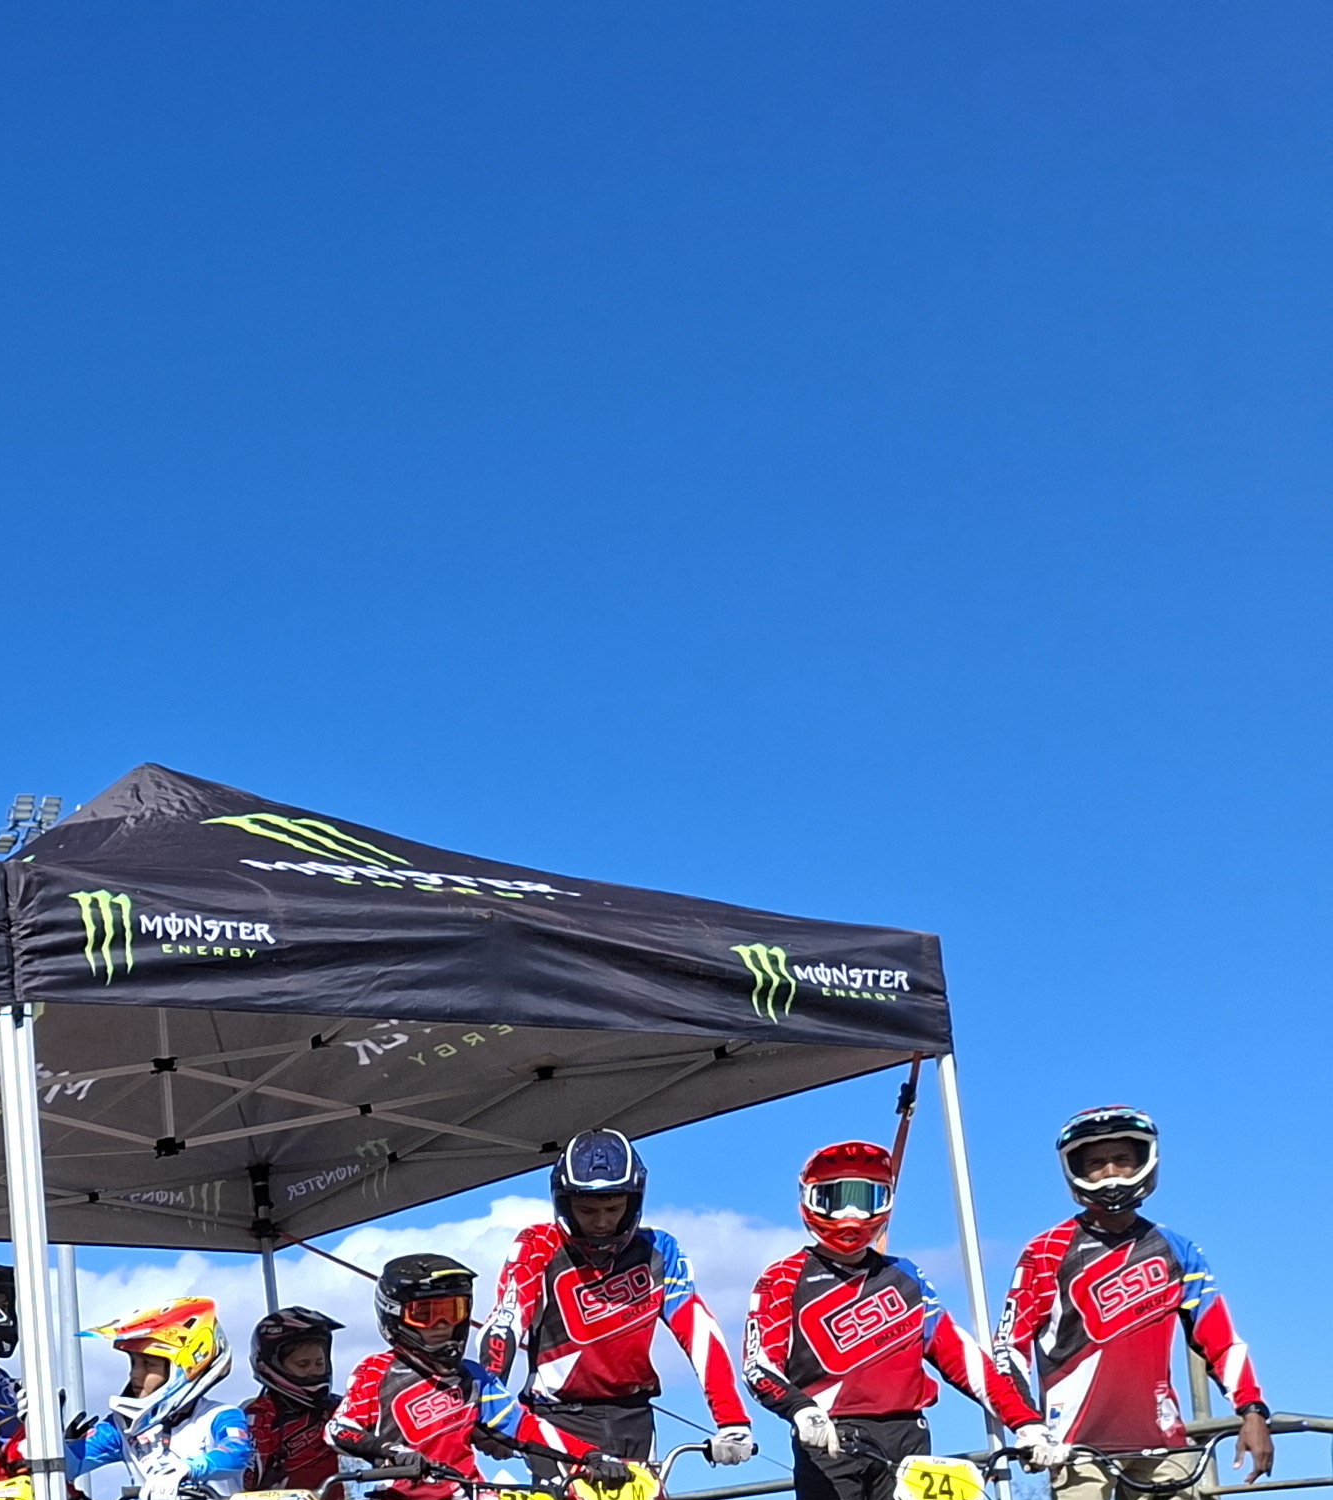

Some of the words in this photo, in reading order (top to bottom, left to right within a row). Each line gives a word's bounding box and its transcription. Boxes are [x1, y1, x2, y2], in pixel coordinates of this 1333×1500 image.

[139, 914, 276, 944] MONSTER
[162, 944, 256, 958] ENERGY
[793, 963, 910, 992] MONSTER
[822, 988, 897, 1002] ENERGY
[756, 1377, 788, 1401] 974
